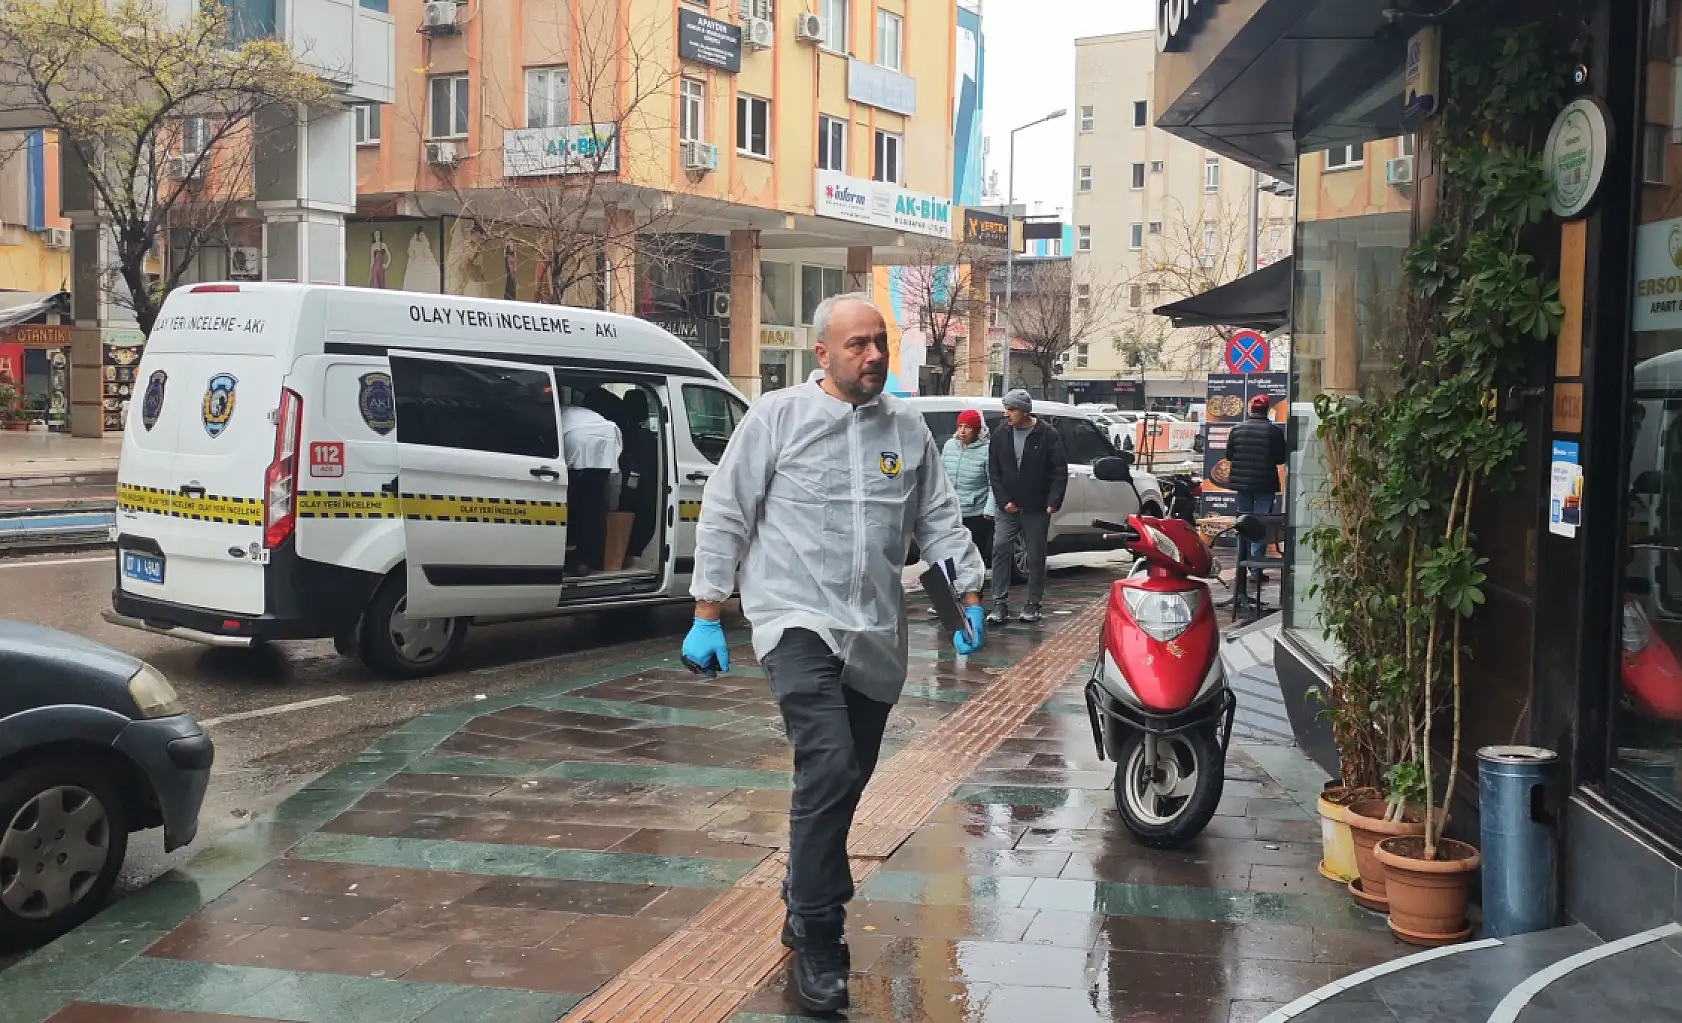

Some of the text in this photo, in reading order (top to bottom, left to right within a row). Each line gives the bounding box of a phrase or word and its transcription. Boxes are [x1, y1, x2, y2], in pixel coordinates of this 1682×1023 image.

[835, 185, 865, 205] inform
[895, 195, 948, 223] AK-BİM
[1650, 300, 1676, 314] APART
[409, 305, 450, 325] OLAY
[456, 309, 493, 329] YERİ
[496, 312, 572, 335] İNCELEME
[595, 322, 618, 338] AKİ
[314, 445, 340, 463] 112
[300, 499, 382, 509] OLAY YERİ İNCELEME
[460, 505, 478, 514] OLAY
